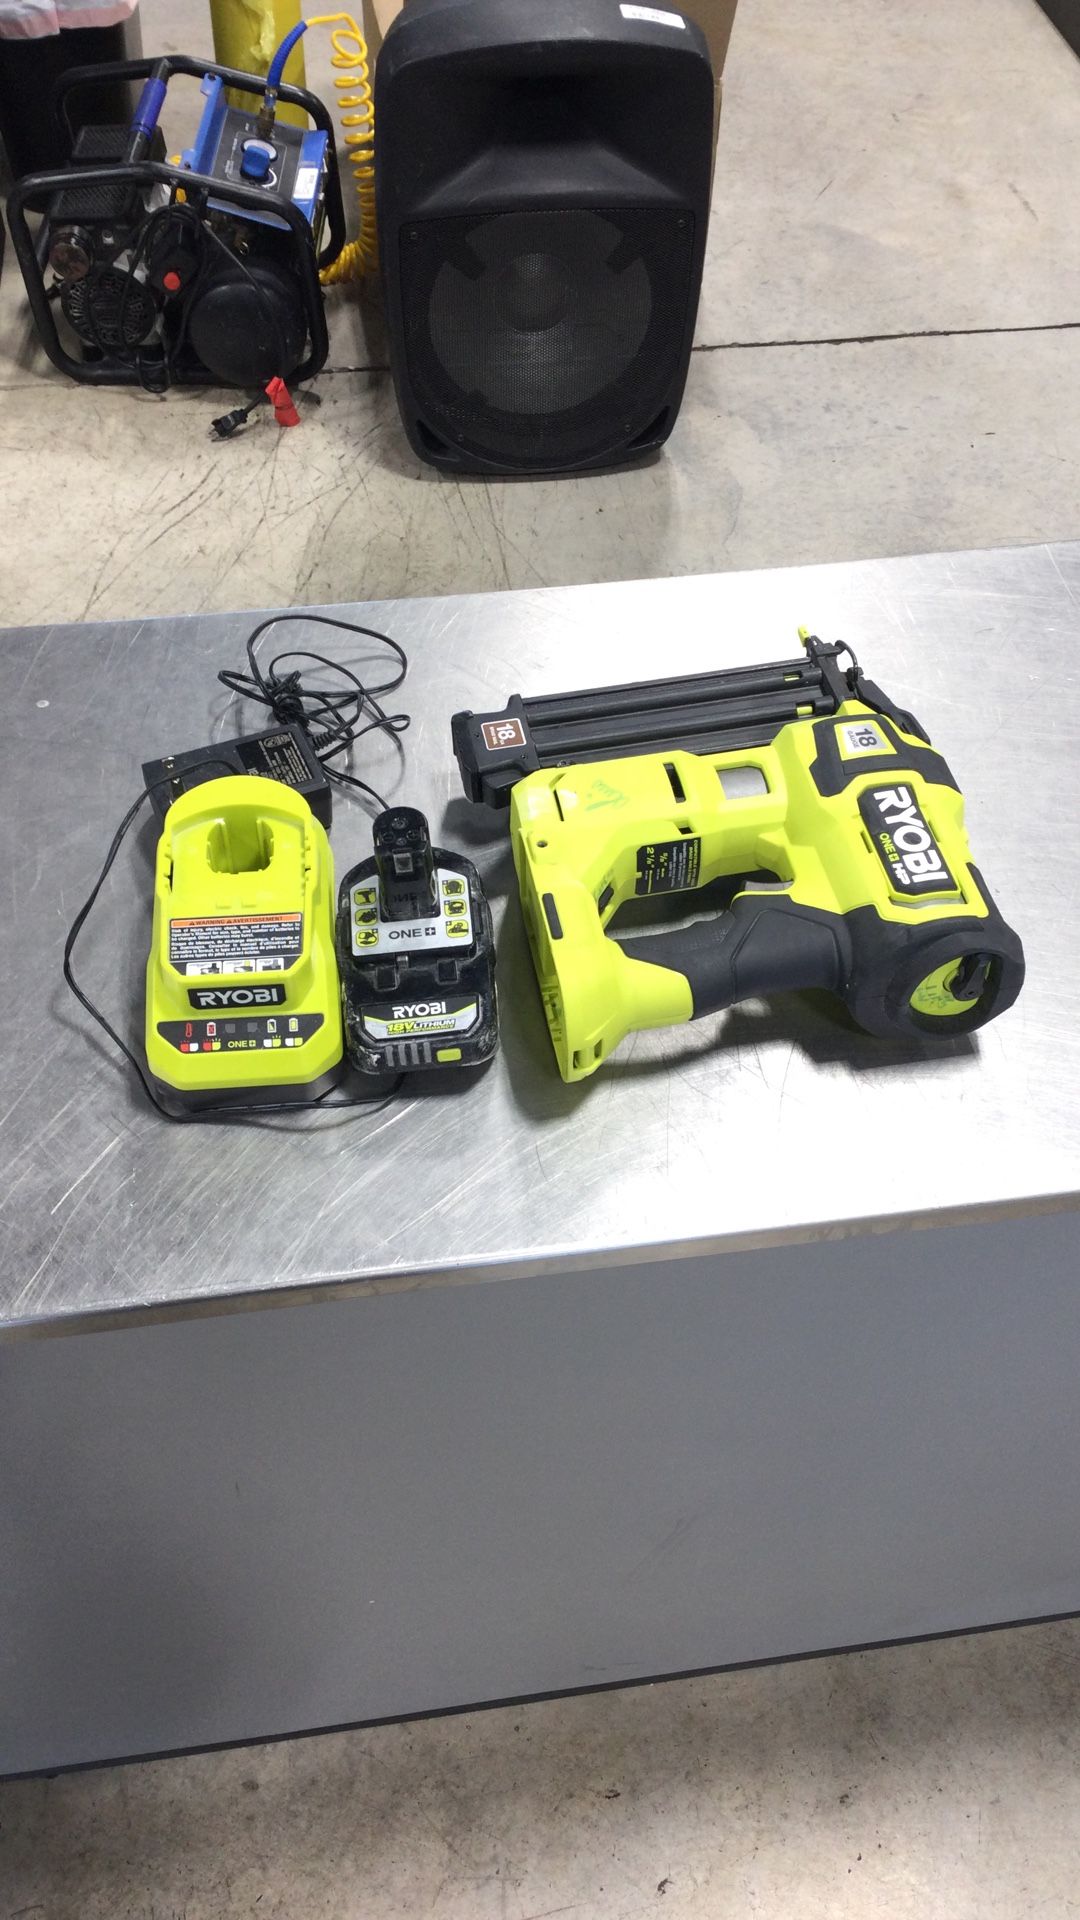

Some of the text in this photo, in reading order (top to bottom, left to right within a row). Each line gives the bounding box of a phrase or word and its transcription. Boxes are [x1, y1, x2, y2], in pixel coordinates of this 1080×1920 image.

[496, 723, 516, 740] 18
[848, 730, 860, 748] GAUGE
[855, 728, 878, 747] 18
[873, 786, 948, 883] RYOBI
[892, 862, 911, 885] HP
[197, 988, 278, 1006] RYOBI
[392, 1002, 447, 1019] RYOBI
